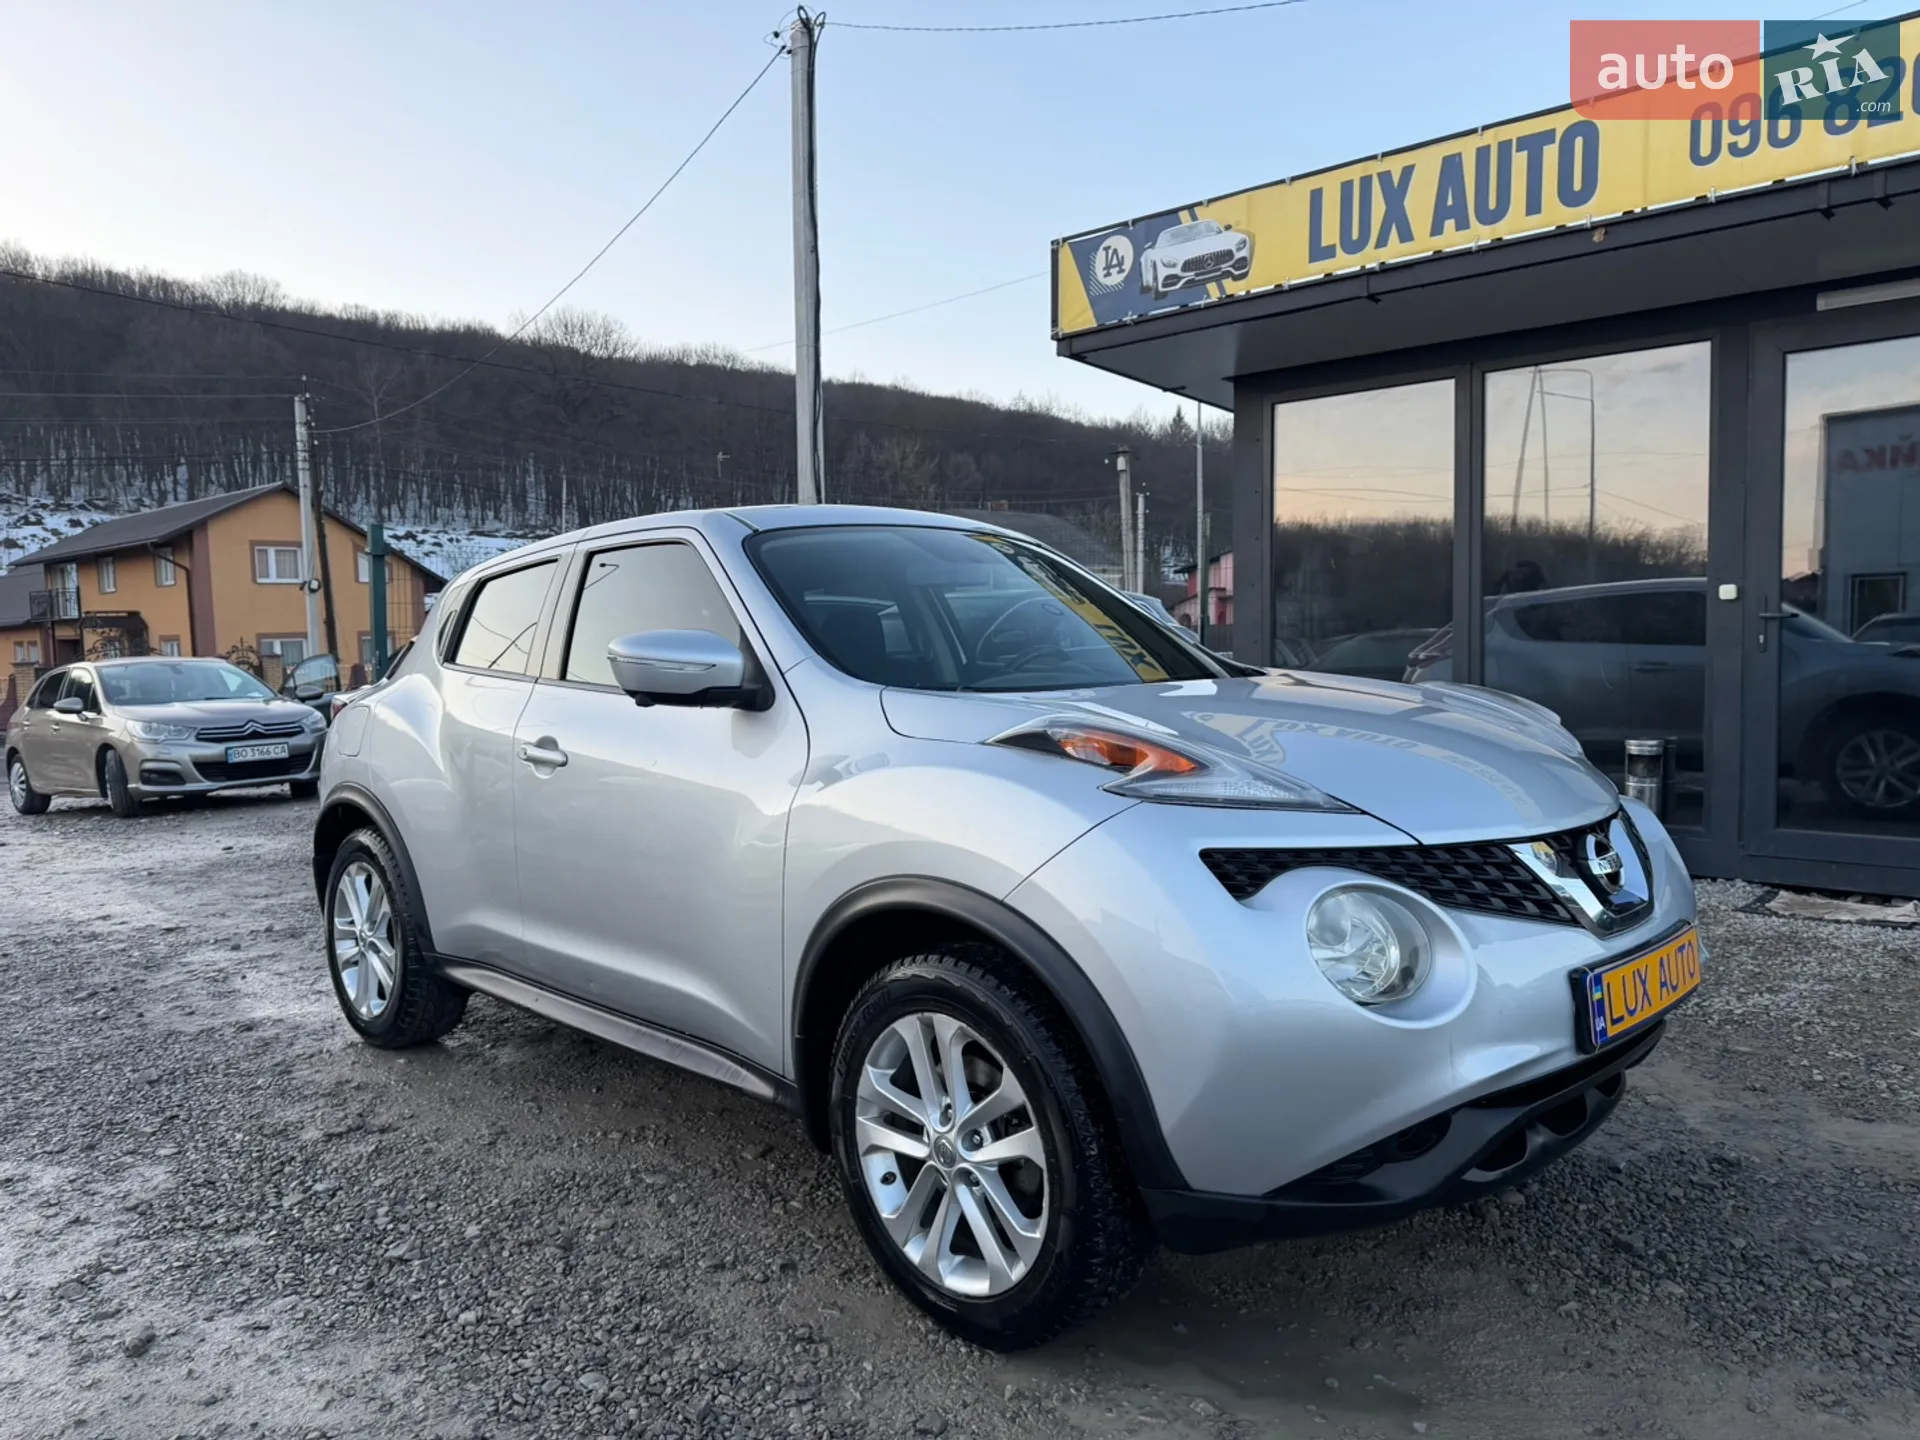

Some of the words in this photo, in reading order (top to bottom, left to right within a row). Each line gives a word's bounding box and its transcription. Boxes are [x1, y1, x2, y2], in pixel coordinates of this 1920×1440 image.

[1308, 162, 1416, 264] LUX
[1429, 119, 1600, 238] AUTO
[1689, 86, 1803, 166] 096
[1823, 53, 1920, 136] 82
[1102, 245, 1126, 278] LA
[250, 747, 272, 757] 3166
[1606, 963, 1652, 1026] LUX
[1659, 939, 1697, 1000] AUTO
